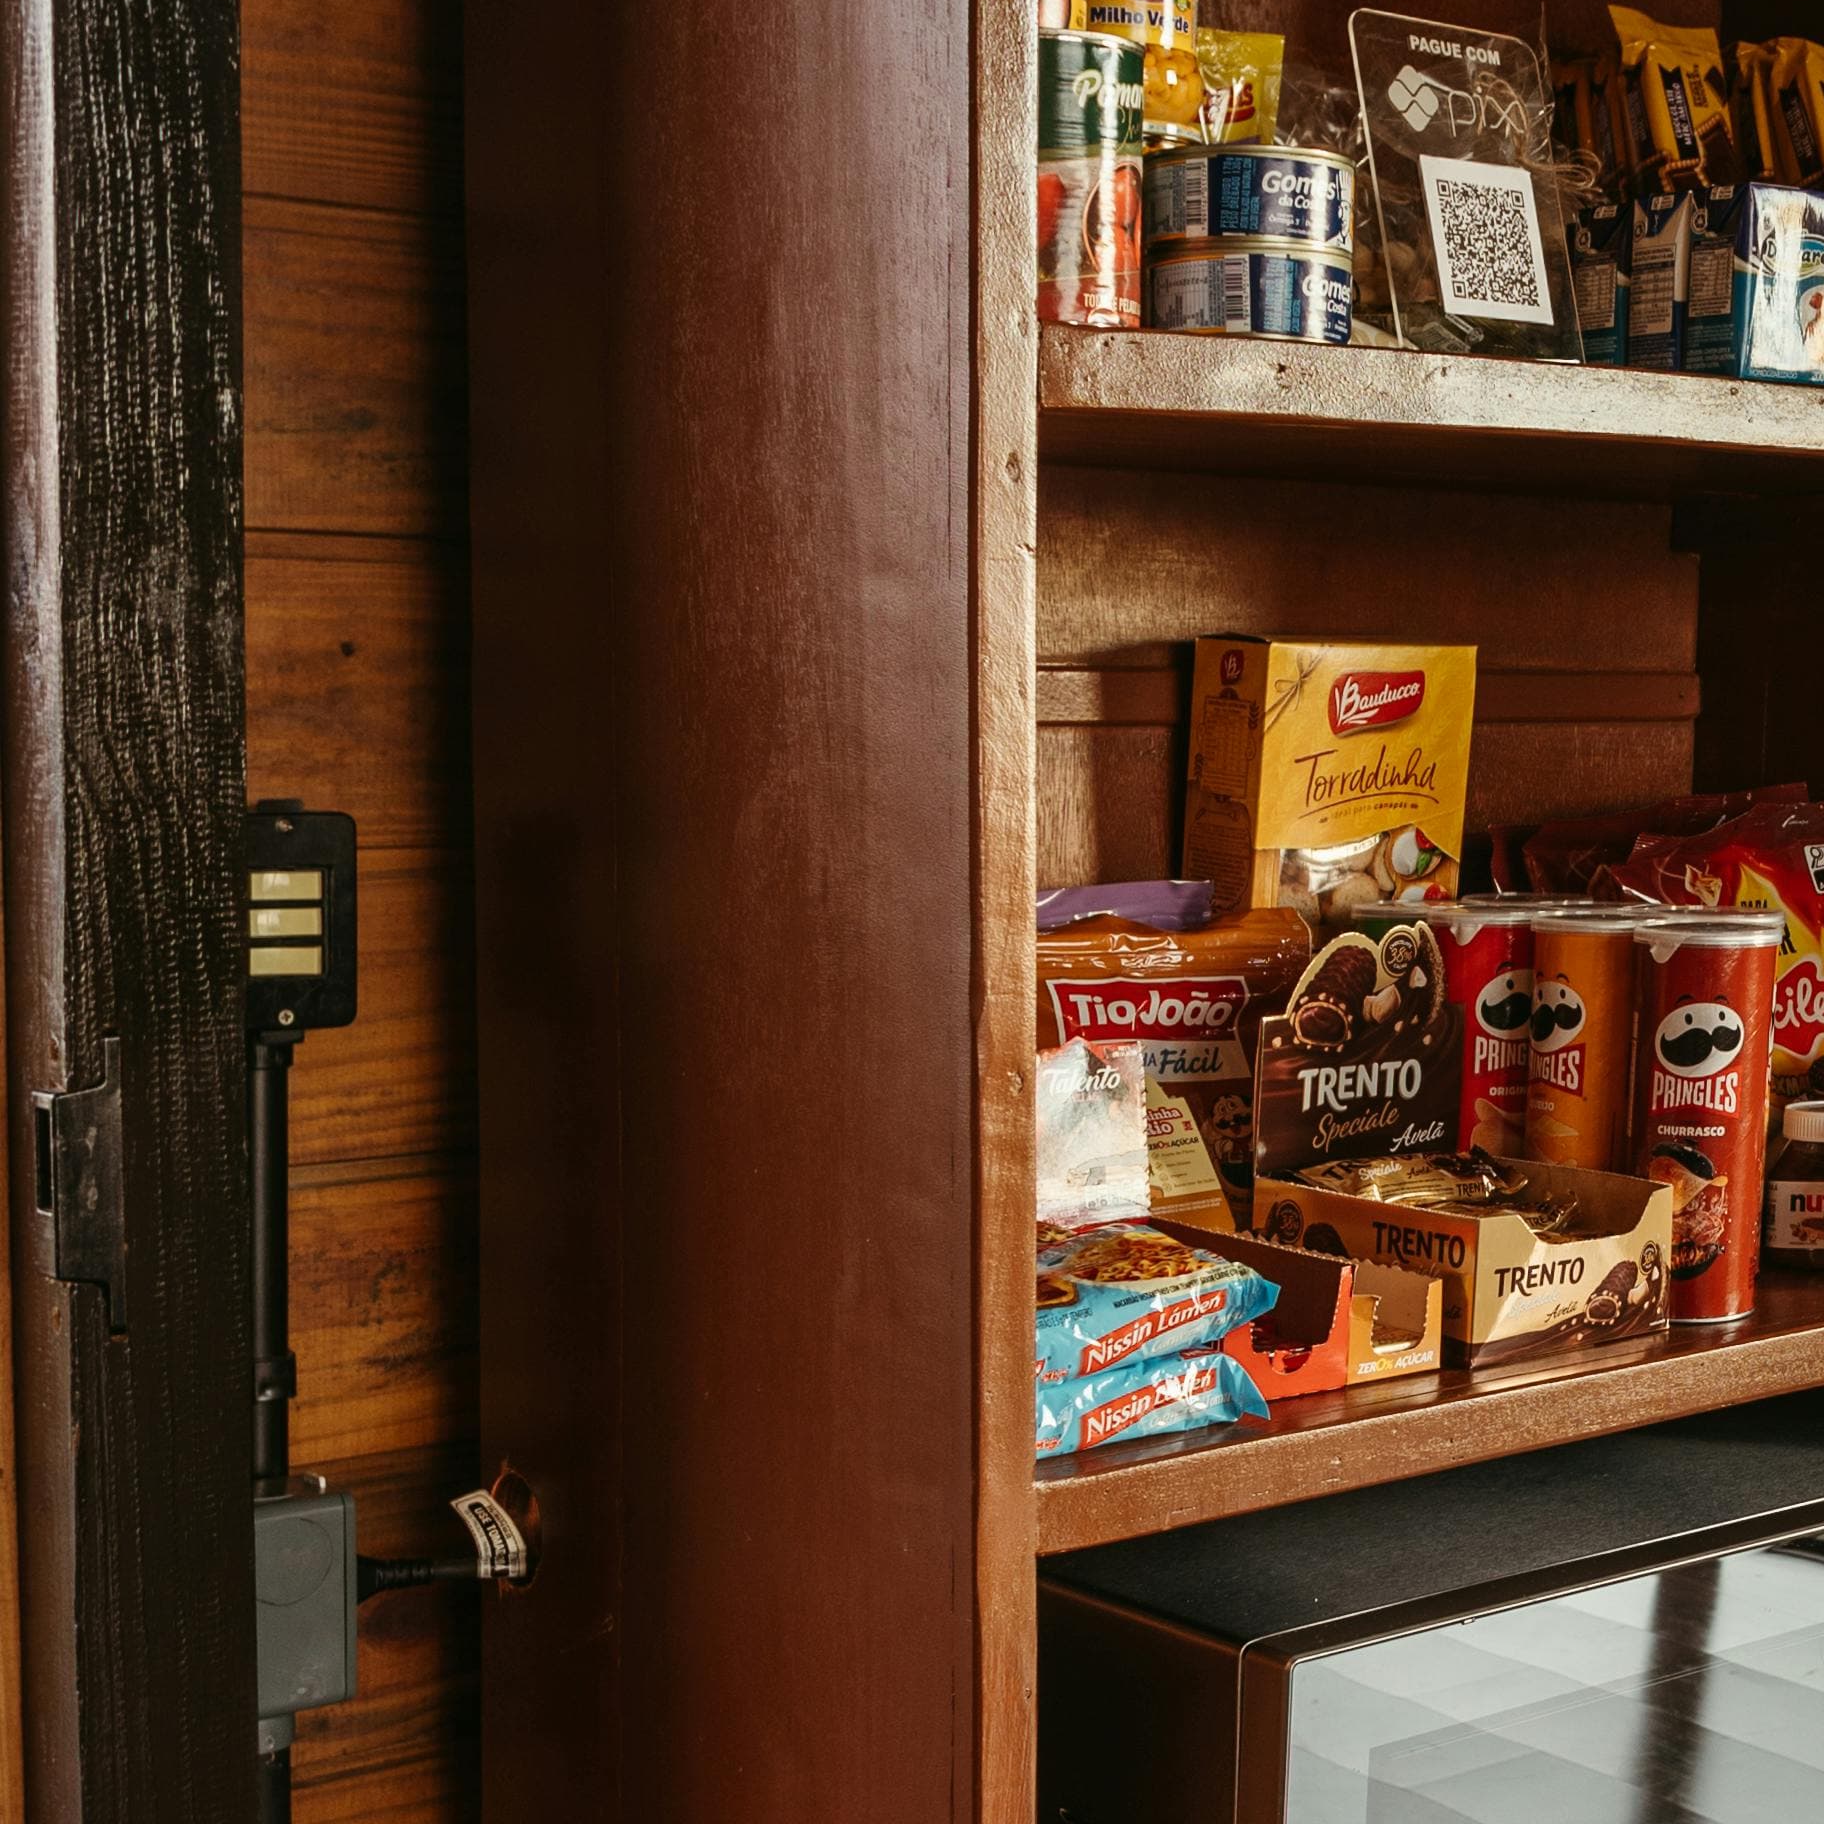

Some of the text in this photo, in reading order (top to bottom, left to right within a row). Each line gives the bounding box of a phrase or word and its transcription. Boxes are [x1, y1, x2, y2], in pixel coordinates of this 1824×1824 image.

[1090, 6, 1189, 34] Milho Vede
[1409, 34, 1501, 66] PAGUE COM
[1448, 84, 1525, 138] pix
[1302, 275, 1351, 304] Gomes
[1335, 676, 1421, 725] Bauducco
[1294, 744, 1438, 808] Torradinha
[1158, 1047, 1225, 1077] Fácil
[1297, 1058, 1422, 1113] TRENTO
[1652, 1070, 1739, 1114] PRINGLES
[1312, 1100, 1400, 1154] Speciale
[1389, 1120, 1445, 1153] Avelã
[1657, 1125, 1726, 1138] CHURRASCO
[1372, 1221, 1466, 1269] TRENTO
[1494, 1257, 1585, 1297] TRENTO
[1086, 1321, 1153, 1373] Nissin
[1155, 1292, 1225, 1334] Lámen
[1394, 1349, 1435, 1370] AÇÚCAR
[1086, 1393, 1152, 1444] Nissin
[474, 1506, 491, 1529] USE
